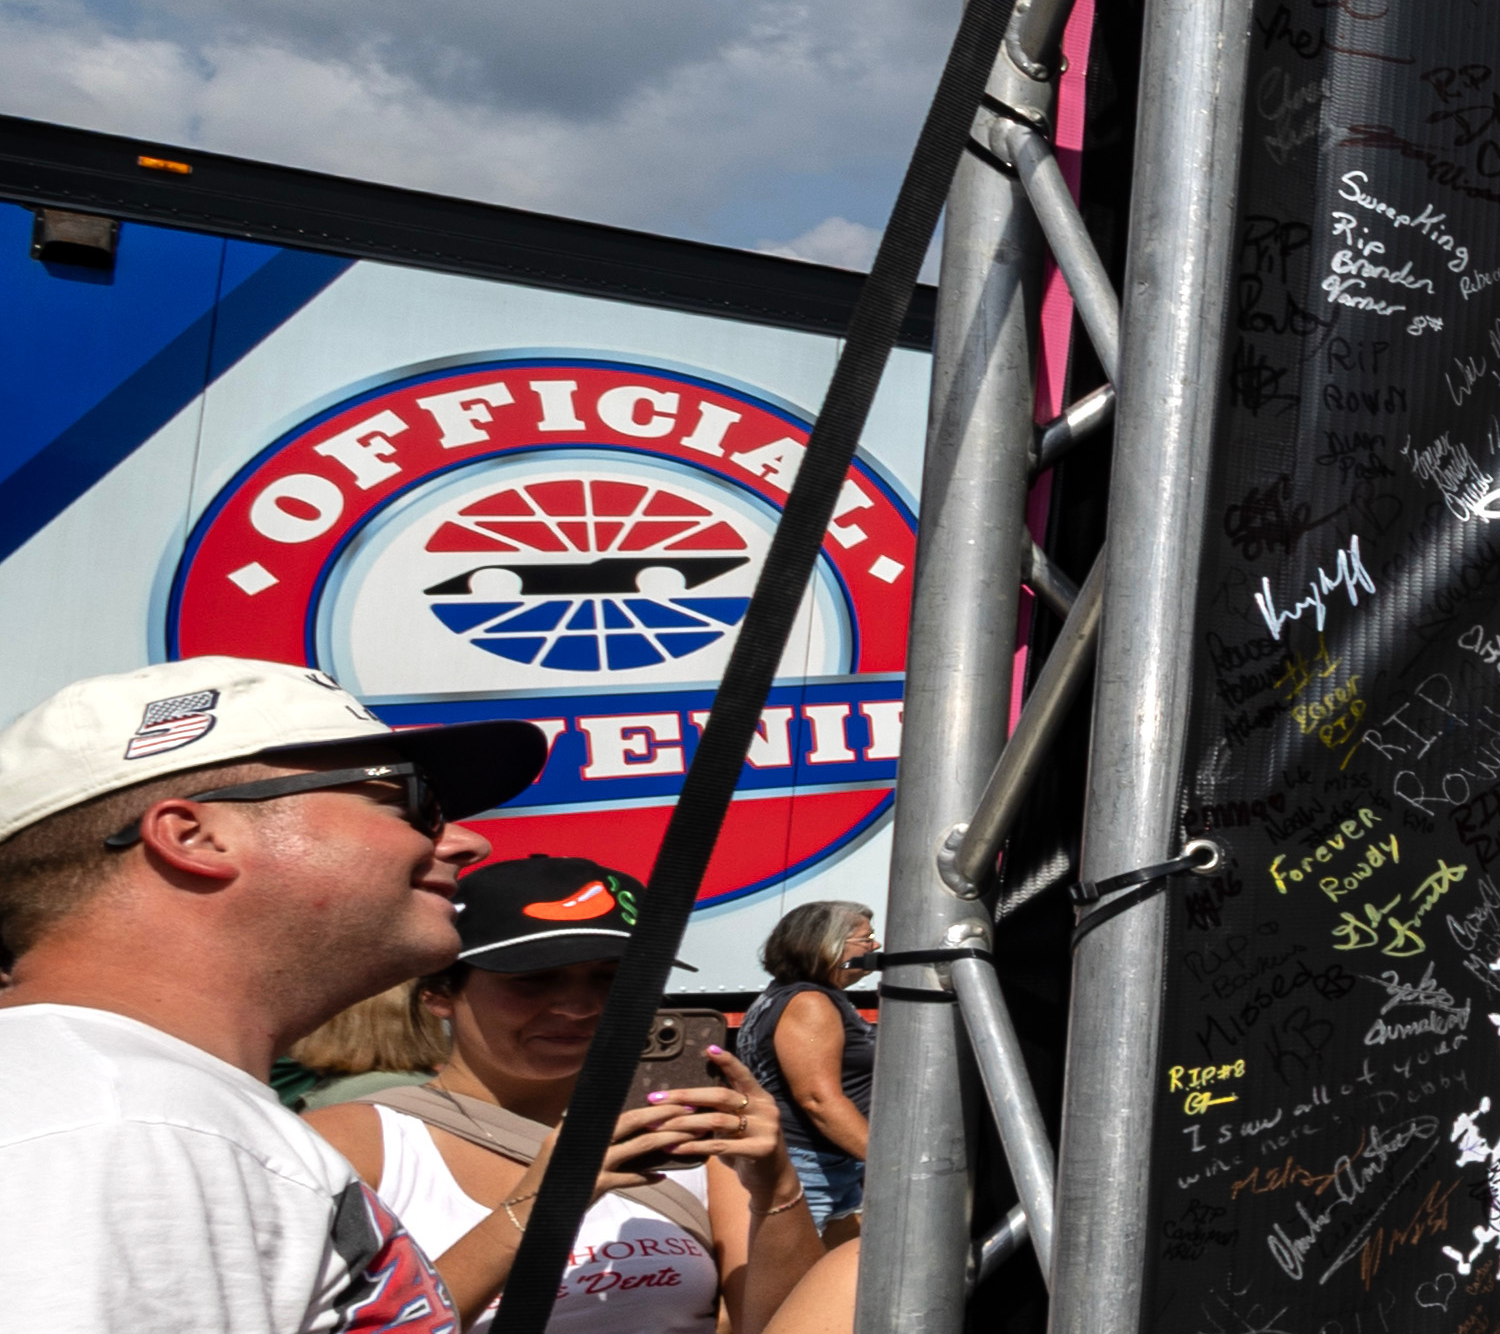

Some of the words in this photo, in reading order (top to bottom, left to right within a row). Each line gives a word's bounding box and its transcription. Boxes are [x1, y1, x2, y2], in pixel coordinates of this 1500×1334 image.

[1332, 211, 1385, 256] Rip
[249, 378, 890, 547] OFFICIAL
[568, 1238, 702, 1267] HORSE
